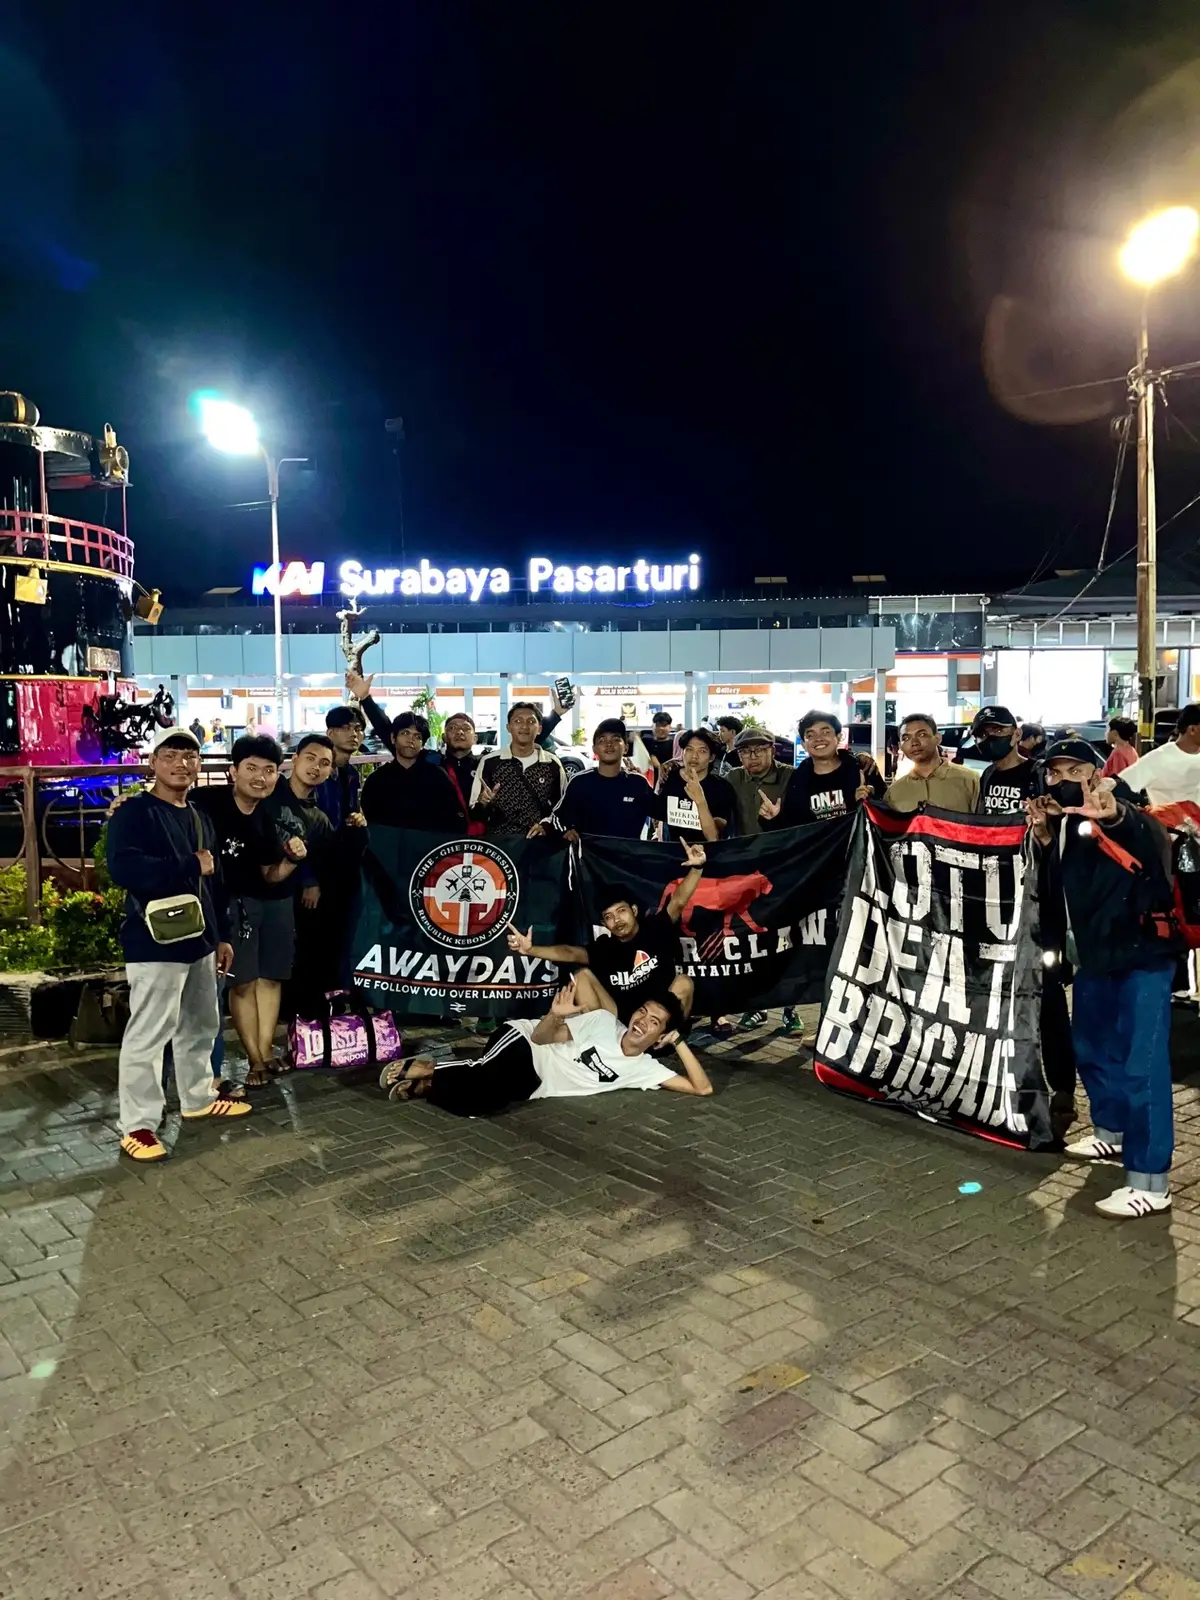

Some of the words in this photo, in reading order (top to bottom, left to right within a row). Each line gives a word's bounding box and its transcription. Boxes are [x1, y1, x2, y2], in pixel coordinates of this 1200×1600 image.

[252, 561, 325, 595] KAI
[340, 558, 510, 602] Surabaya
[529, 553, 700, 593] Pasarturi
[715, 687, 740, 695] Gallery
[985, 796, 1009, 809] ROES
[989, 785, 1021, 799] LOTUS
[463, 844, 484, 852] FOR
[485, 848, 514, 880] PERSIJA
[418, 909, 453, 944] REPUBLIK
[454, 934, 486, 945] KEBON
[488, 911, 510, 937] JERUK
[724, 908, 841, 961] CLAW
[355, 943, 560, 984] AWAYDAYS
[610, 957, 659, 986] ellesse
[675, 962, 753, 977] BATAVIA
[837, 896, 1017, 1031] DEAT
[353, 976, 371, 988] WE
[373, 980, 421, 995] FOLLOW
[423, 986, 447, 998] YOU
[449, 989, 479, 999] OVER
[482, 989, 513, 1000] LAND
[515, 990, 540, 1000] AND
